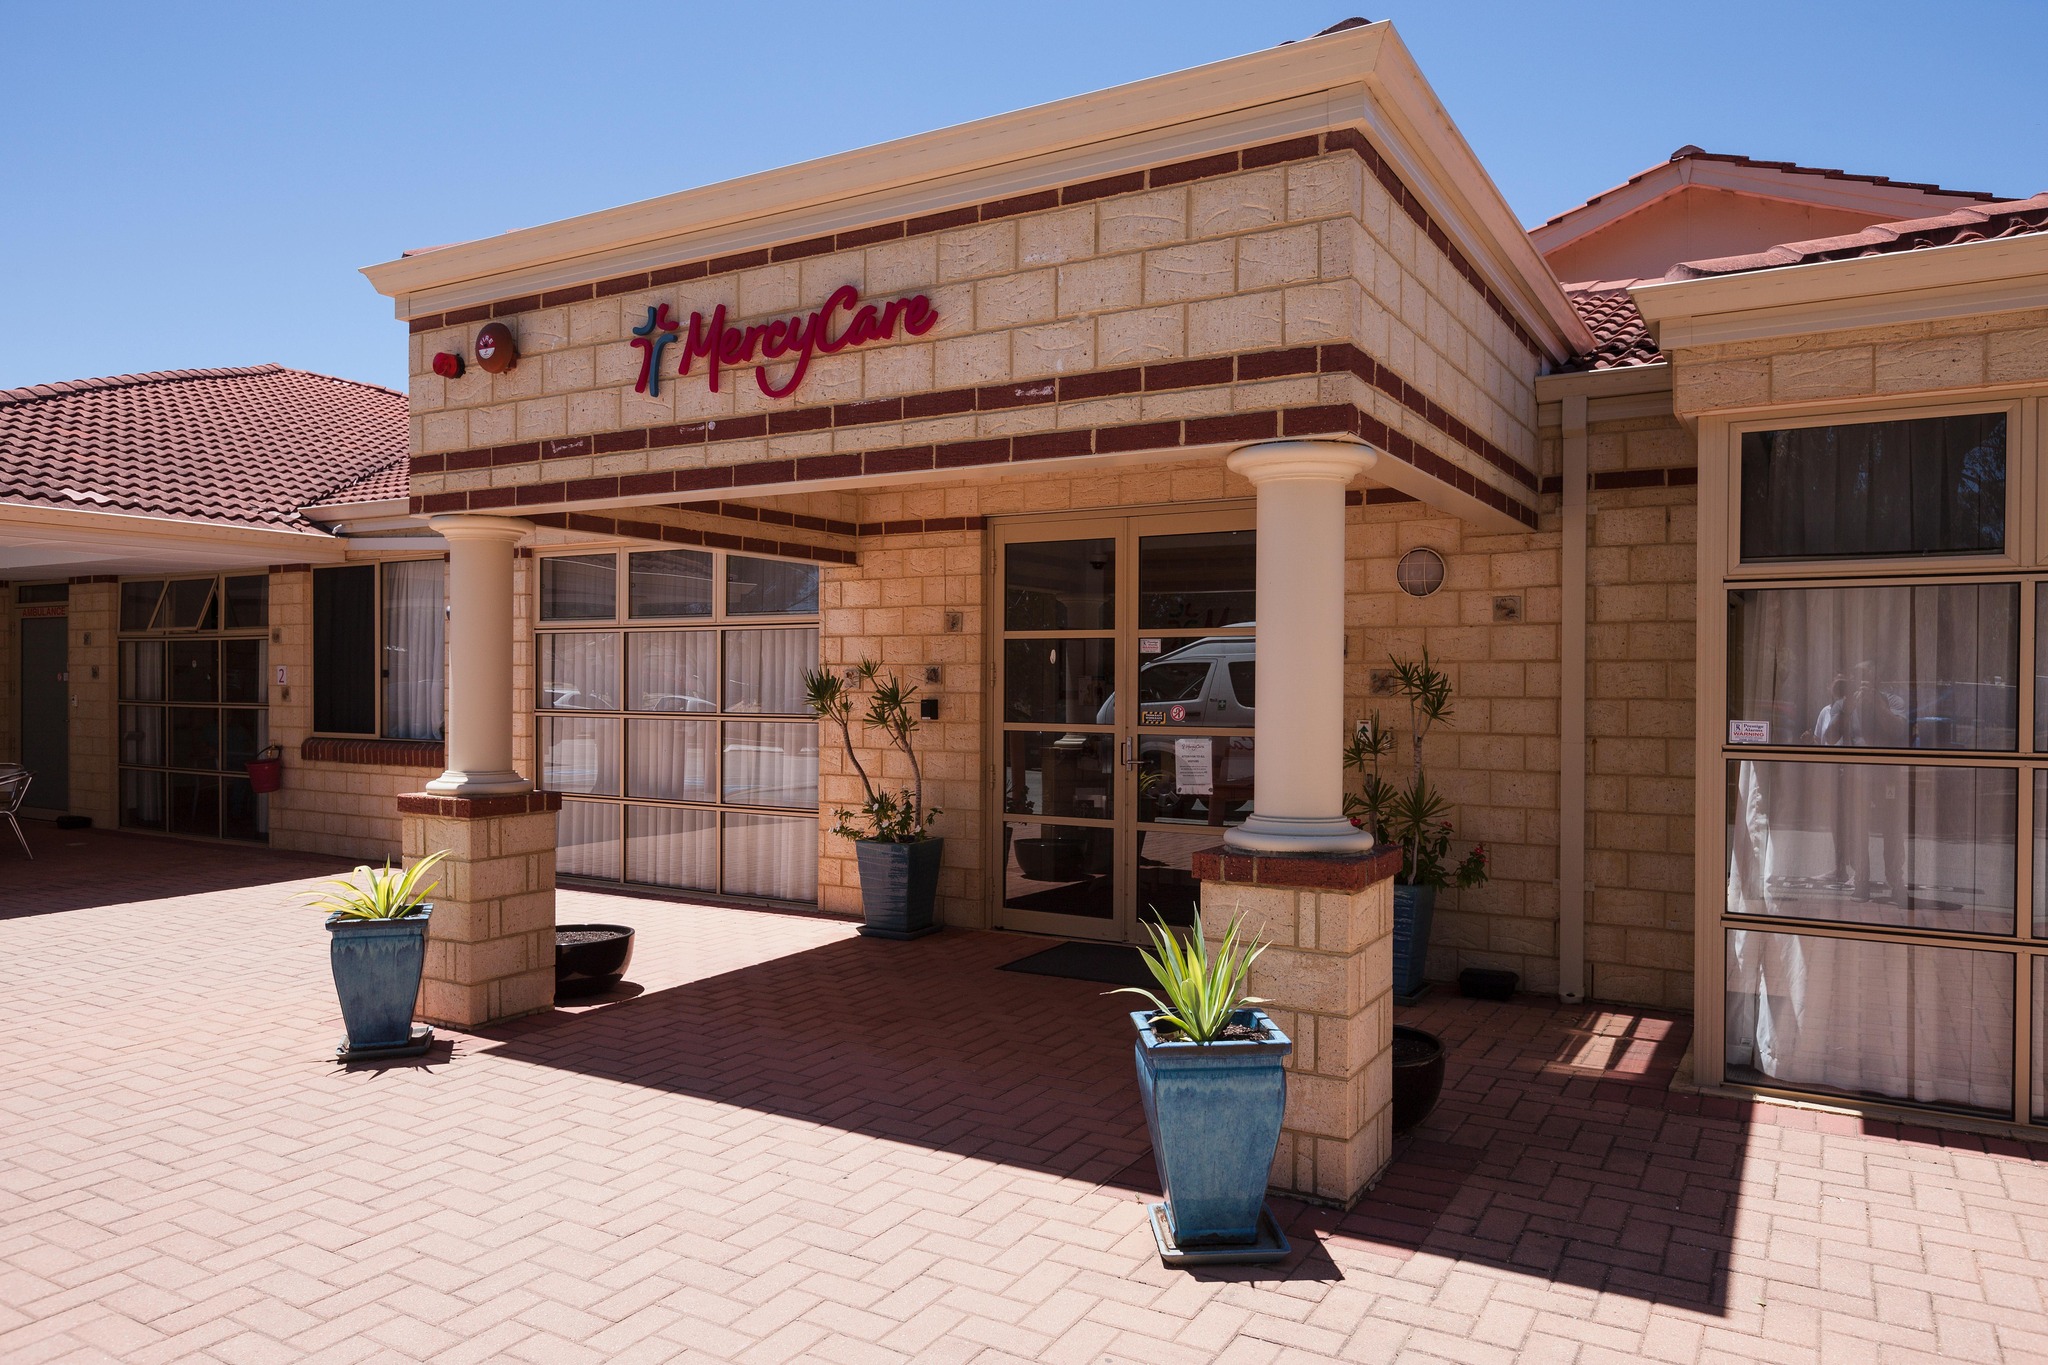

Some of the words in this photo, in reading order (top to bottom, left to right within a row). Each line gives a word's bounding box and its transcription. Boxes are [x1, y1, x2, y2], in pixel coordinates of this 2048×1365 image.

[479, 335, 494, 346] FIRE
[678, 285, 939, 399] MercyCare
[22, 606, 66, 617] AMBULANCE
[278, 668, 285, 683] 2
